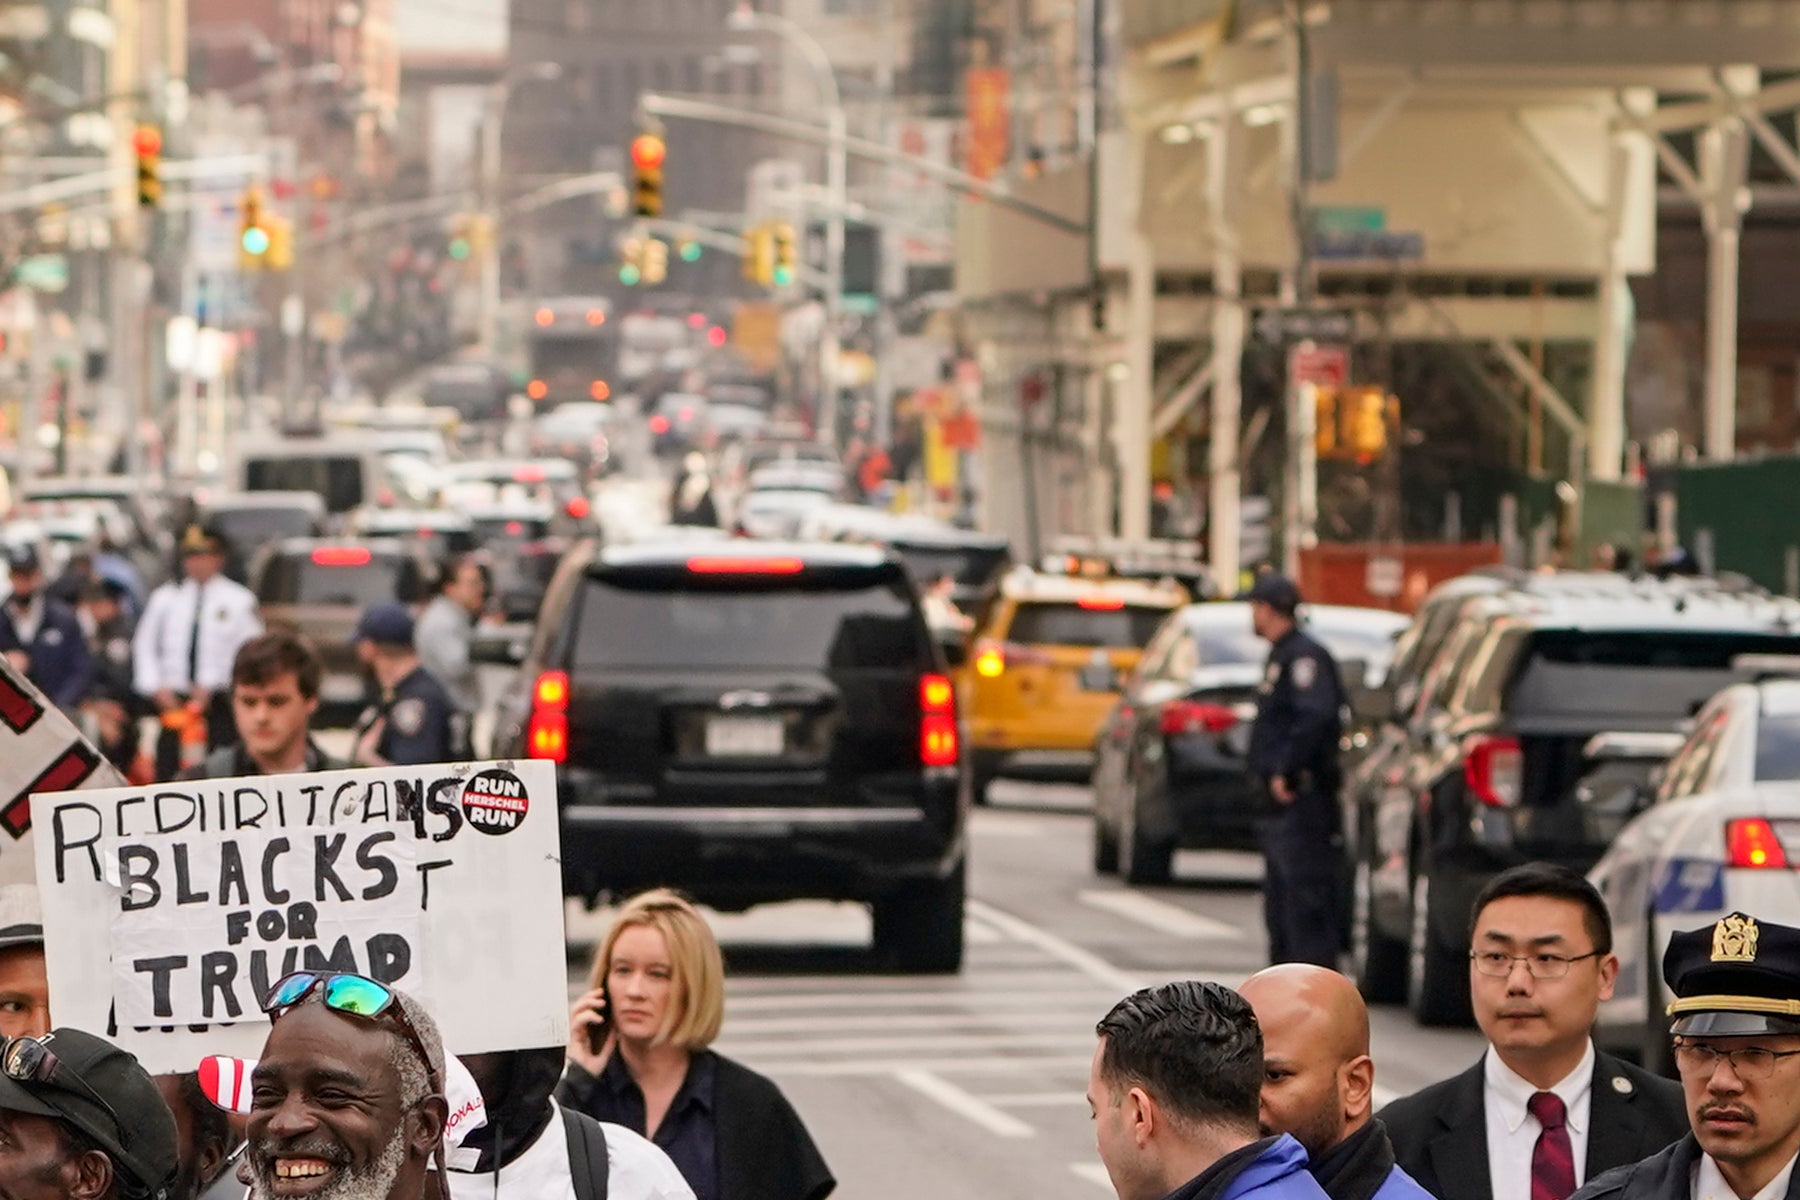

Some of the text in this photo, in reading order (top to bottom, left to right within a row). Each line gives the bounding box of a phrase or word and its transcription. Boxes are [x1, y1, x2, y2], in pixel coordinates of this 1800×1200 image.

[473, 776, 521, 798] RUN
[463, 793, 526, 811] HERSCHEL
[470, 806, 517, 828] RUN
[119, 830, 398, 912] BLACKS
[227, 901, 318, 945] FOR
